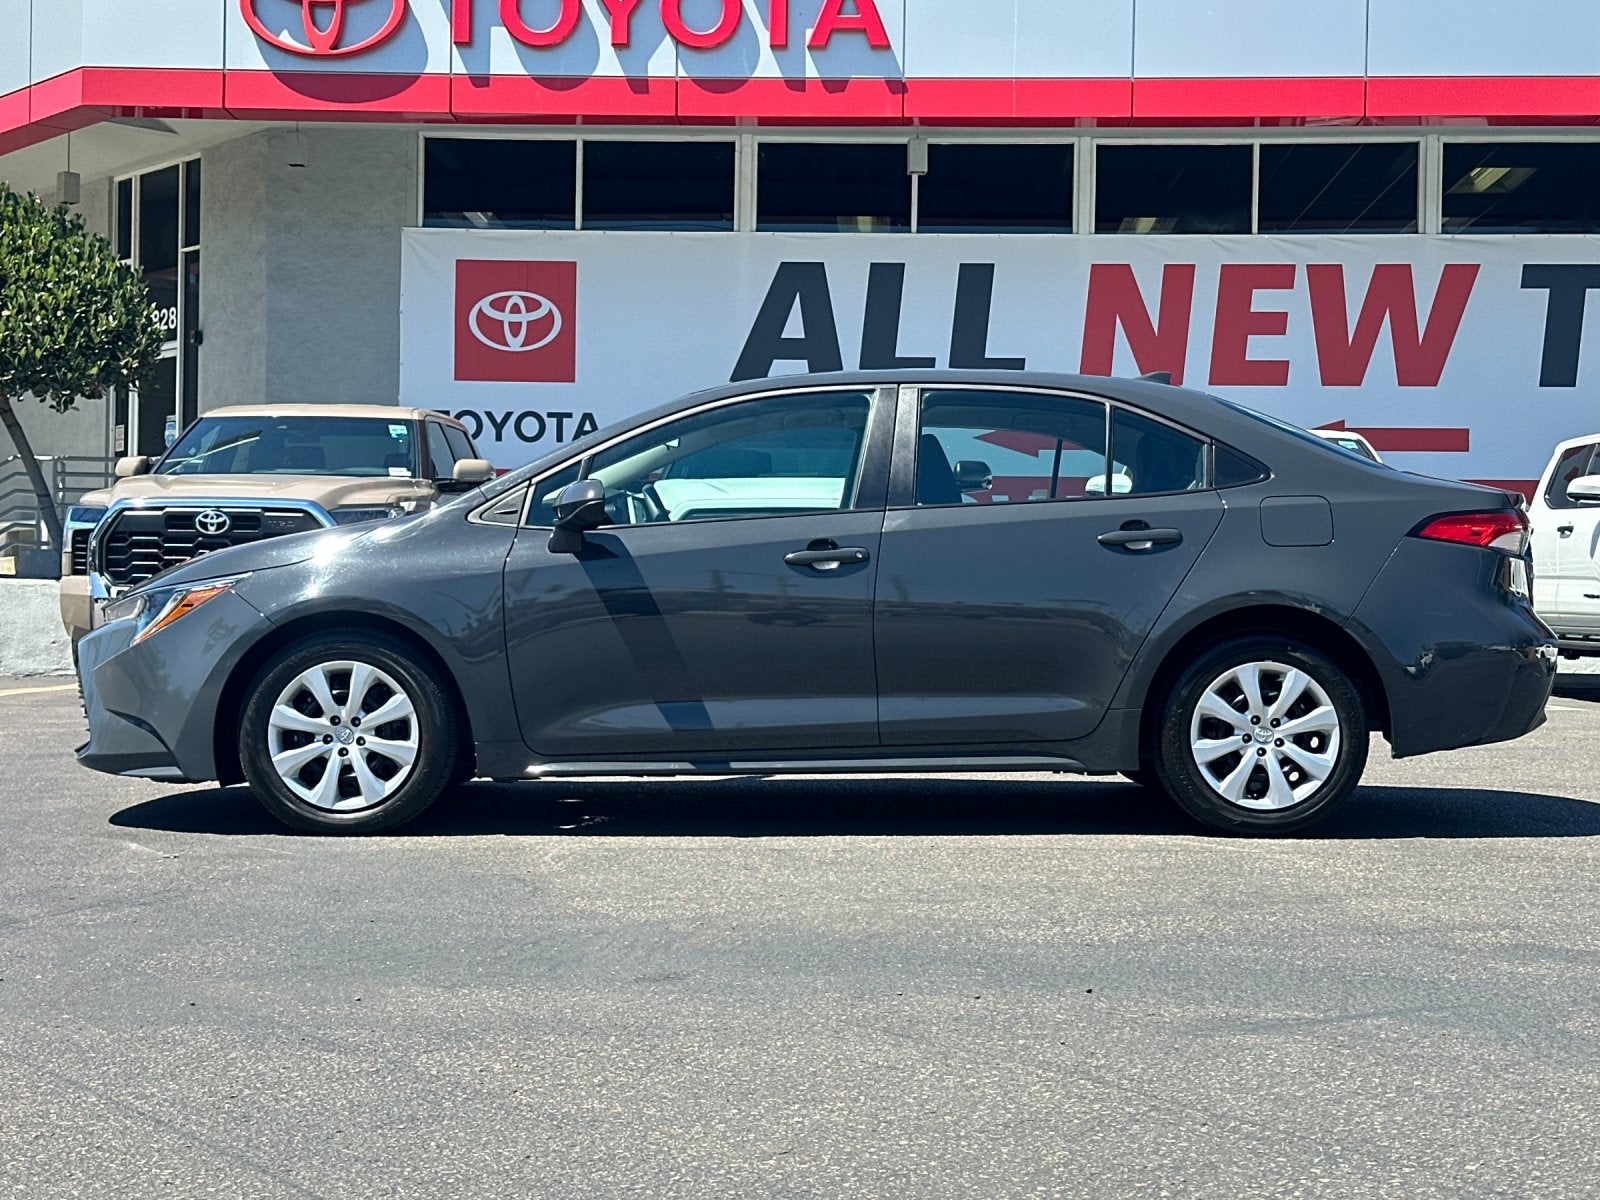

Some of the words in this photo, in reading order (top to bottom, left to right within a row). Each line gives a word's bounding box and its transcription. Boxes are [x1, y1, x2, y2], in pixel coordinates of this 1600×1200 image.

[729, 261, 1026, 383] ALL
[1079, 263, 1481, 388] NEW
[432, 409, 599, 443] OYOTA
